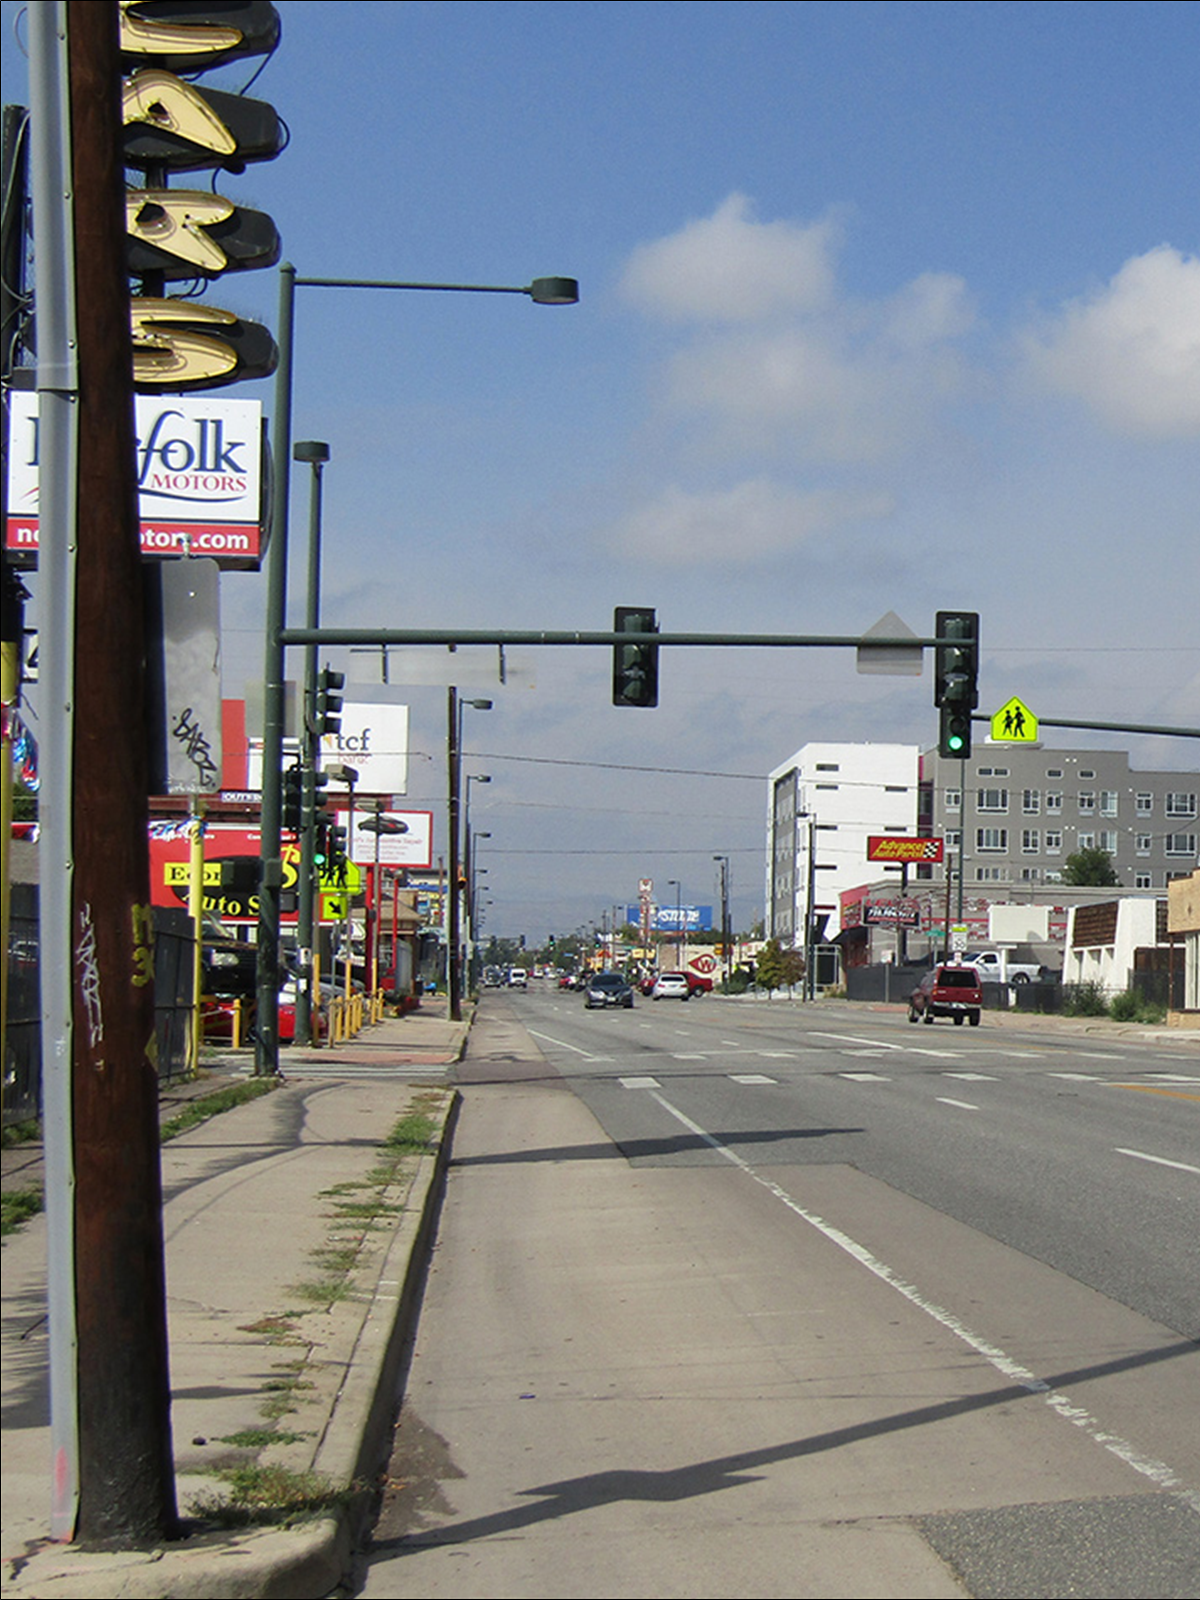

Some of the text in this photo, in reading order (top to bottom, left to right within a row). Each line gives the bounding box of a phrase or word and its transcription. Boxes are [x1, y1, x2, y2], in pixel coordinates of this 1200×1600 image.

[151, 474, 247, 492] MOTORS
[335, 728, 371, 751] tcf
[879, 840, 922, 850] Advance
[872, 849, 896, 858] Auto
